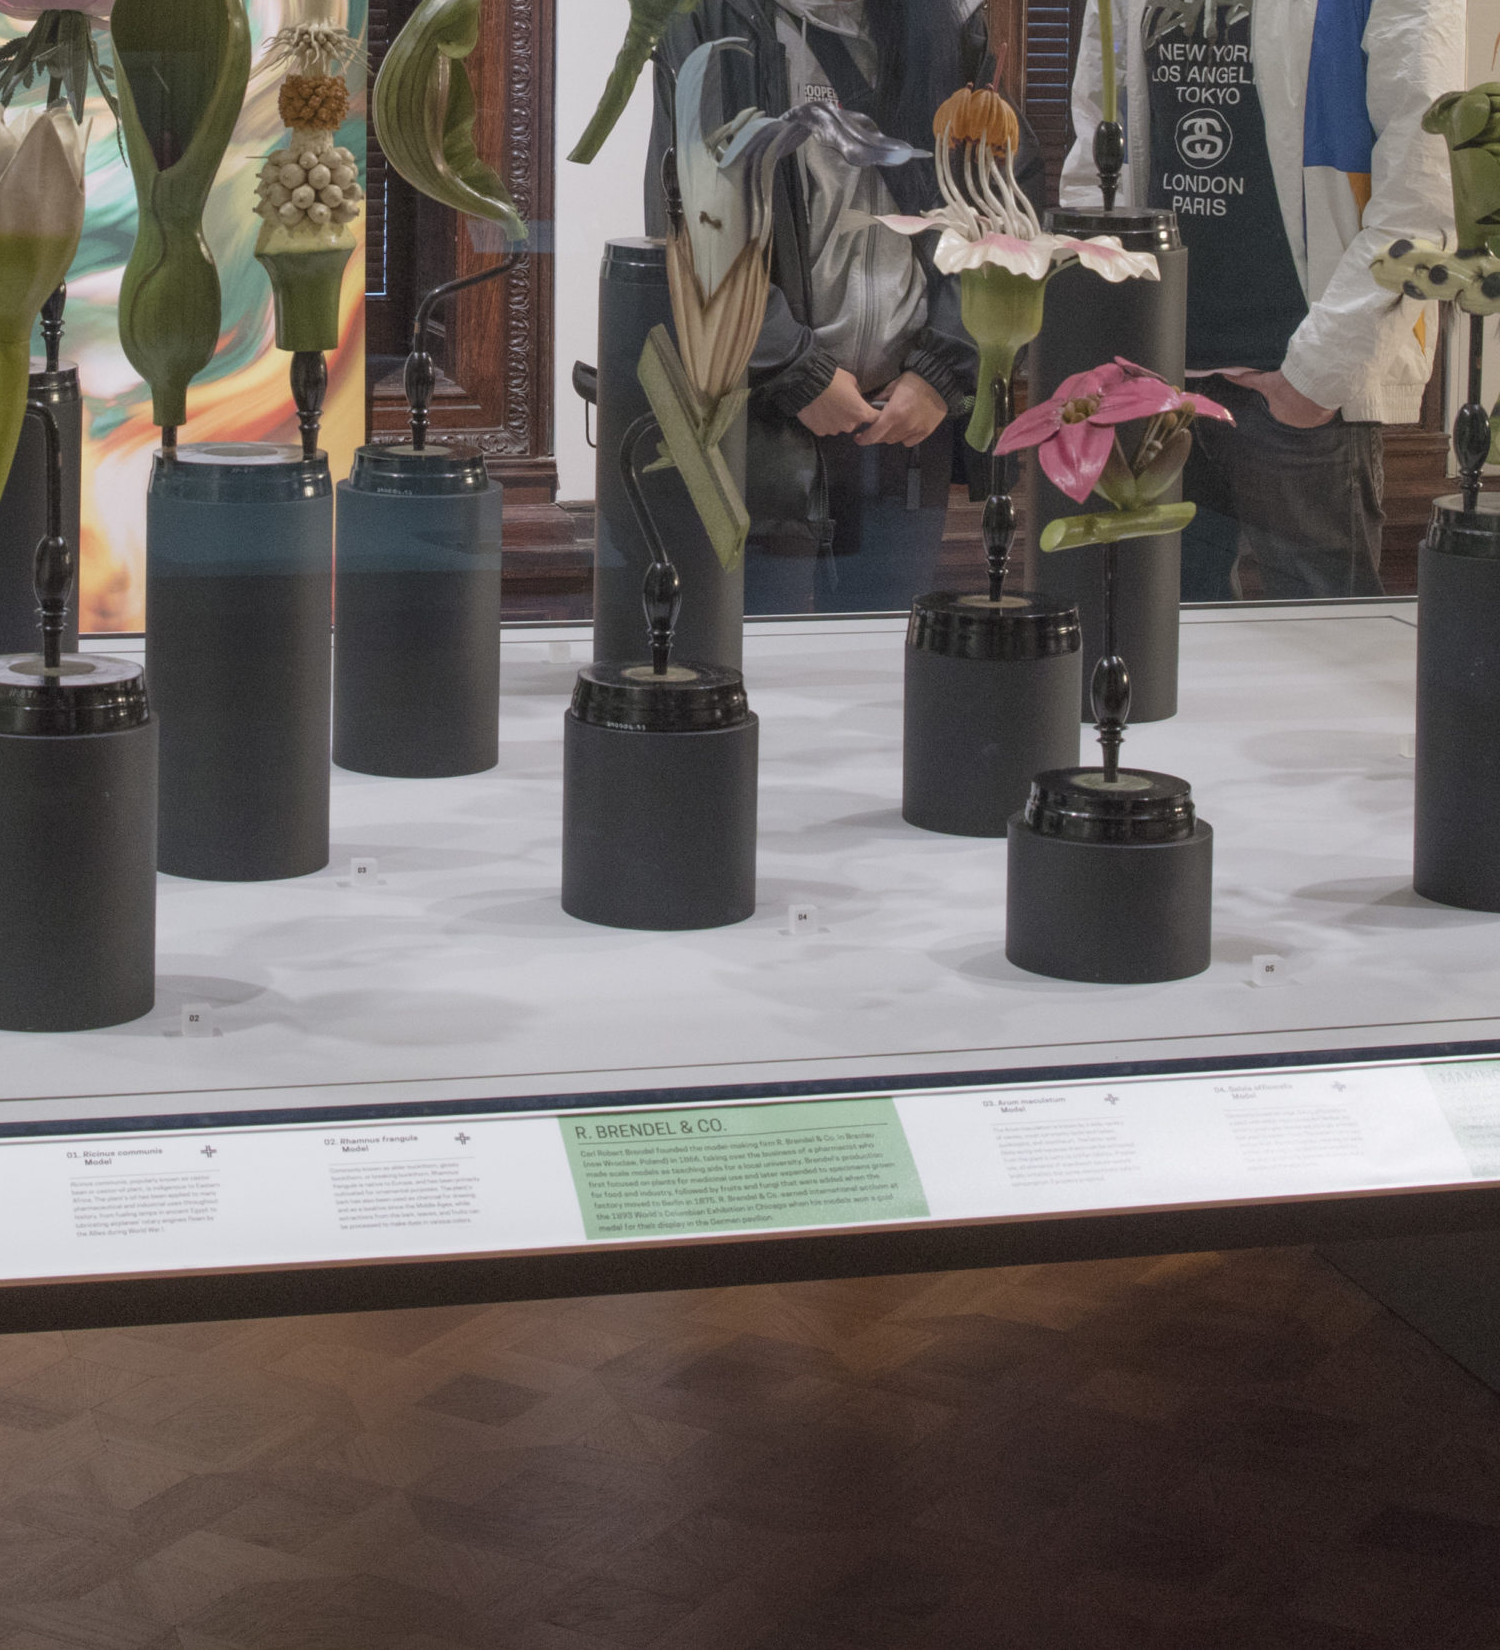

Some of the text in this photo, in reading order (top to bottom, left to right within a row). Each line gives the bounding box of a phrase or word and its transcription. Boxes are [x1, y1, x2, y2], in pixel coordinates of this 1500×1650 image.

[1159, 44, 1252, 62] NEW YOR
[1176, 87, 1240, 105] TOKYO
[1163, 173, 1244, 195] LONDON
[1173, 196, 1226, 216] PARIS
[575, 1118, 727, 1139] R. BRENDEL & CO.
[382, 1135, 418, 1143] frangula
[118, 1148, 162, 1156] communis
